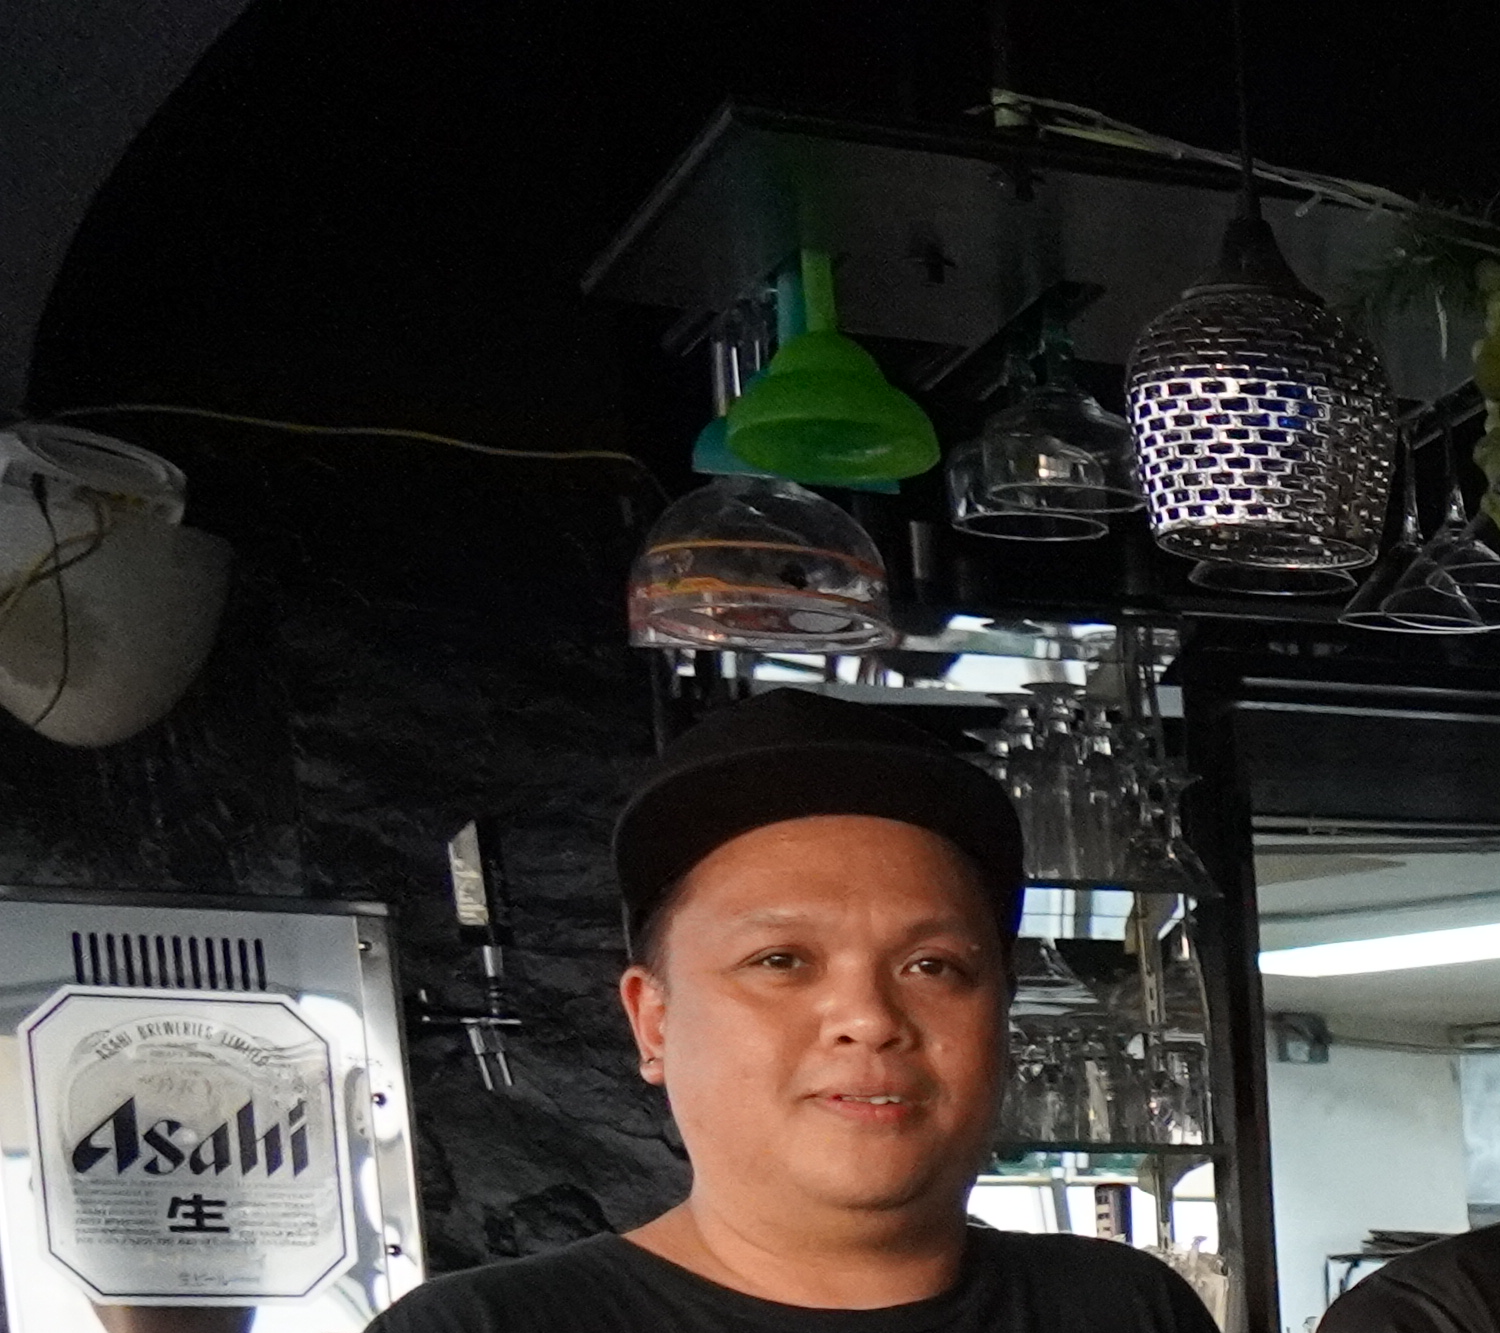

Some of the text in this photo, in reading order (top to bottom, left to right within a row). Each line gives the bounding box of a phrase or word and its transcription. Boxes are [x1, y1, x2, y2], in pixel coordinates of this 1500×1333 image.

[95, 1030, 132, 1061] ASAHI
[137, 1020, 214, 1042] BREWERIES
[72, 1095, 310, 1178] Asahi
[167, 1193, 230, 1234] 生
